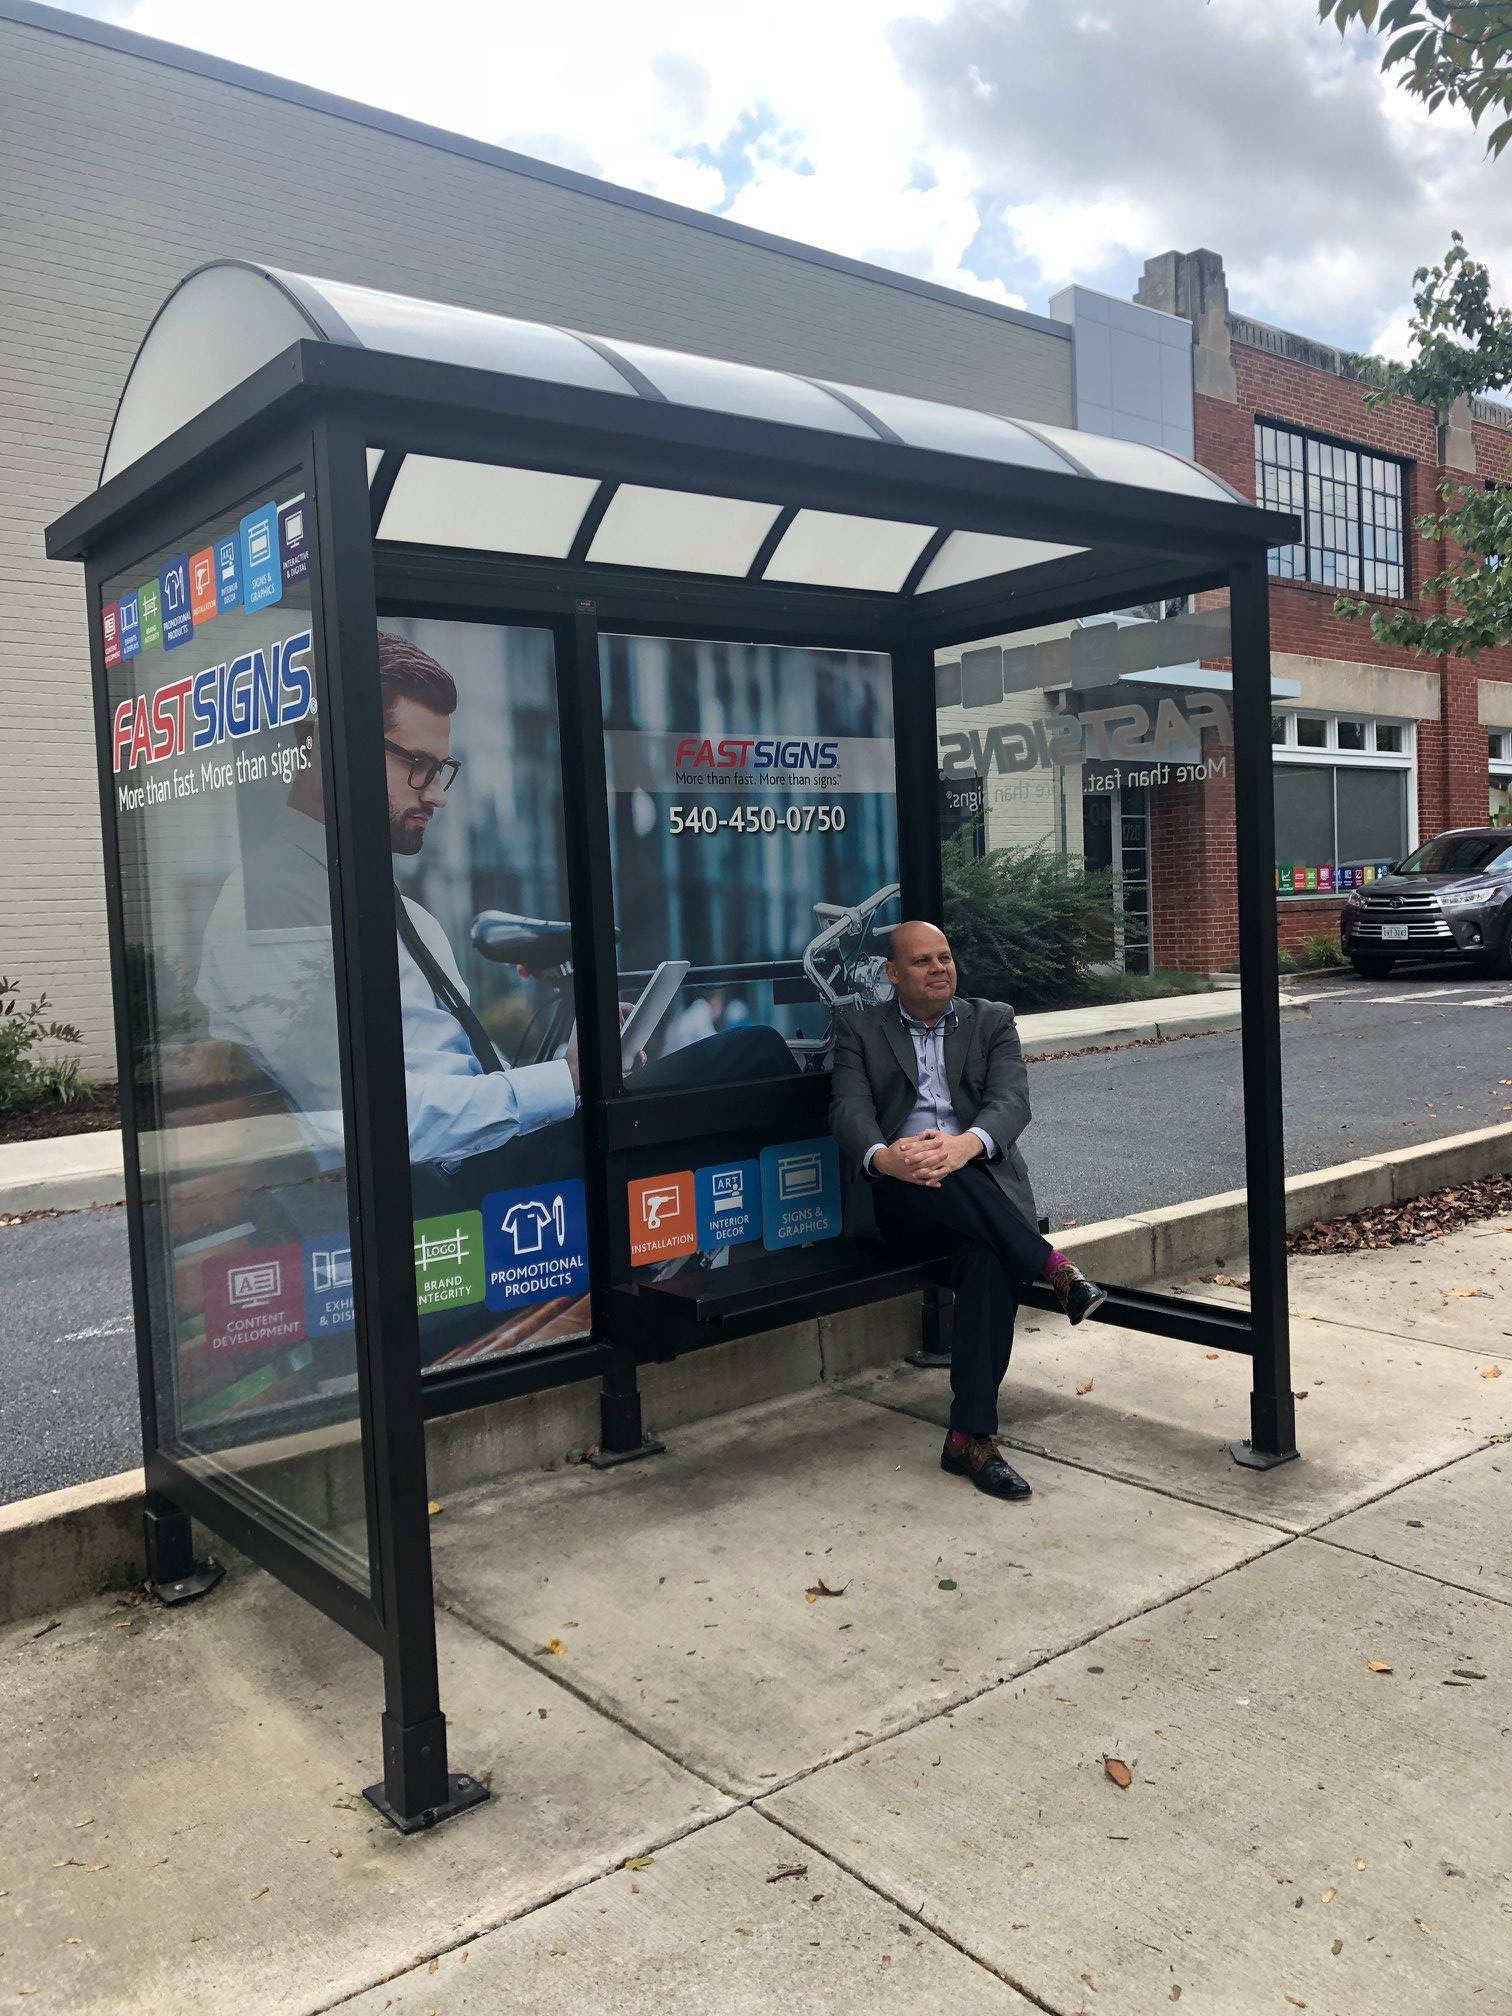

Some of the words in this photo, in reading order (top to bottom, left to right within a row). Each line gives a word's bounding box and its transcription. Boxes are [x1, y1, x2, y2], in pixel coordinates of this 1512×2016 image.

[283, 551, 309, 570] INTERACTIVE
[291, 563, 307, 577] DIGITAL
[252, 574, 267, 589] SIGNS
[250, 583, 275, 603] GRAPHICS
[163, 611, 191, 631] PROMOTIONAL
[168, 624, 188, 641] PRODUCTS
[119, 784, 144, 812] More
[146, 776, 170, 805] than
[173, 769, 199, 799] fast.
[201, 761, 233, 792] More
[236, 751, 267, 784] than
[676, 772, 703, 785] More
[707, 772, 731, 785] than
[734, 772, 756, 785] fast.
[759, 773, 785, 785] More
[788, 773, 811, 786] than
[669, 805, 846, 834] 540-450-0750
[717, 1176, 738, 1190] ART
[709, 1214, 750, 1231] INTERIOR
[782, 1208, 813, 1224] SIGNS
[815, 1206, 823, 1218] &
[716, 1226, 745, 1240] DECOR
[777, 1218, 829, 1239] GRAPHICS
[426, 1243, 456, 1258] LOGO
[631, 1233, 694, 1254] INSTALLATION
[490, 1255, 584, 1285] PROMOTIONAL
[424, 1275, 463, 1292] BRAND
[504, 1272, 572, 1298] PRODUCTS
[418, 1285, 472, 1306] NTEGRITY
[325, 1298, 353, 1312] EXHI
[226, 1311, 286, 1333] CONTENT
[320, 1315, 329, 1327] &
[212, 1320, 300, 1349] DEVELOPMENT
